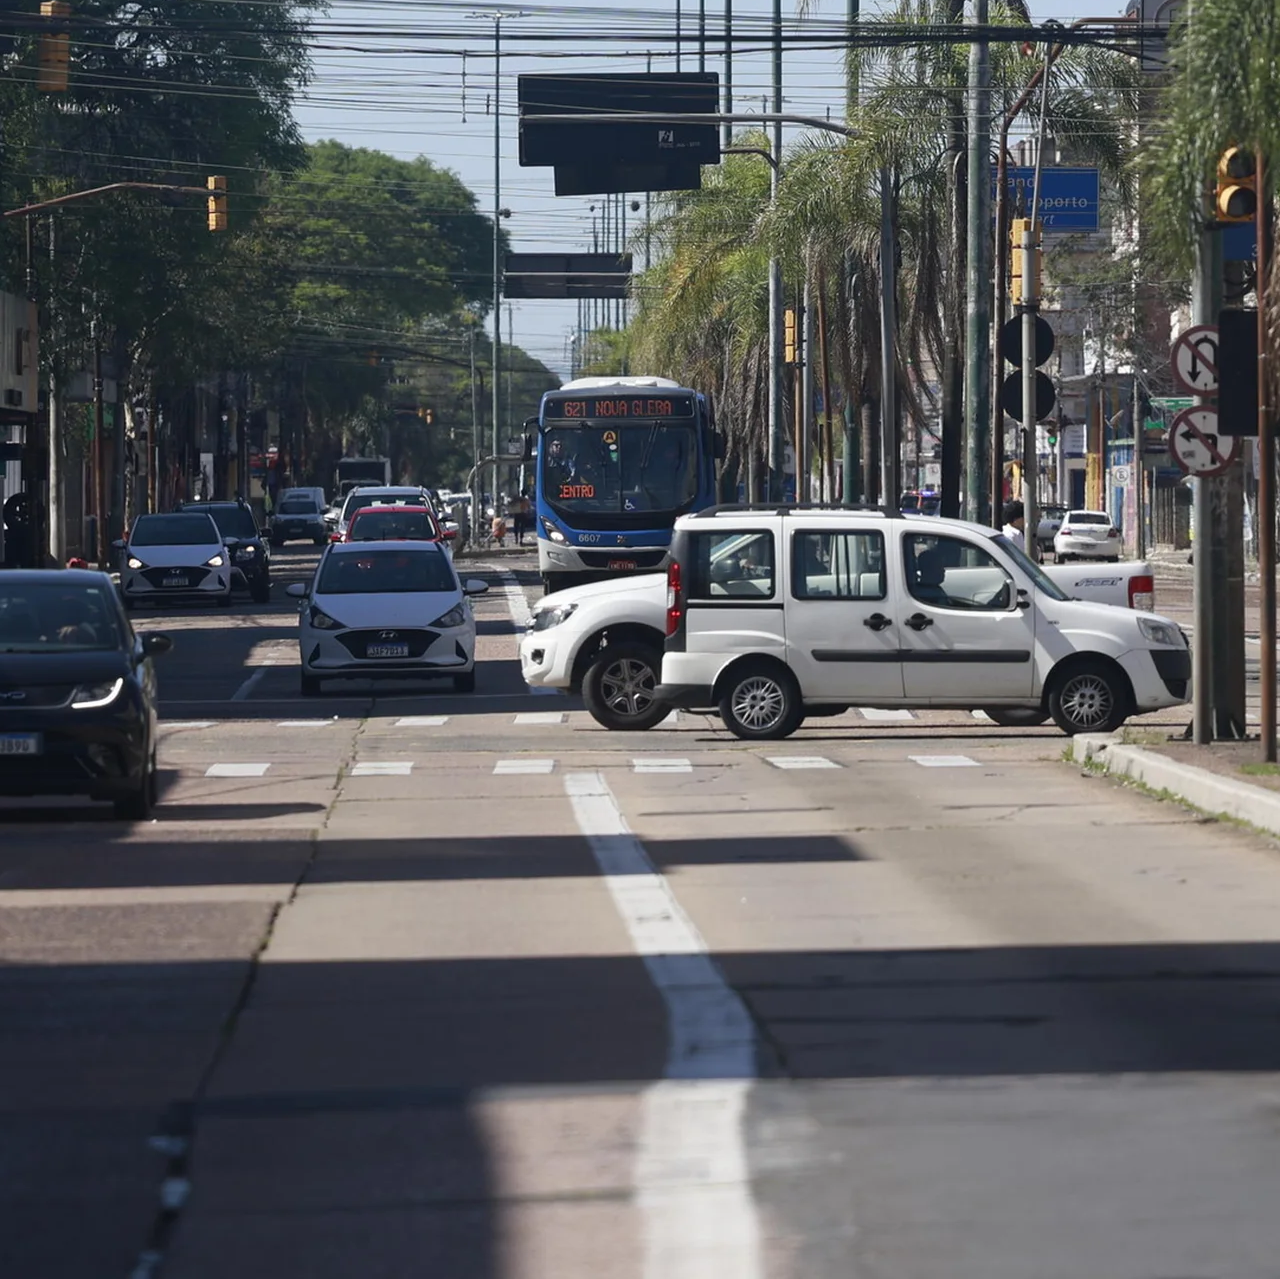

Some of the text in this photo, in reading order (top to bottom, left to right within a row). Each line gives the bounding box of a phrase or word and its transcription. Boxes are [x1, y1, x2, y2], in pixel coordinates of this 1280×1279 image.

[563, 400, 672, 417] 621 NOVA GLEBA
[578, 533, 601, 543] 6607
